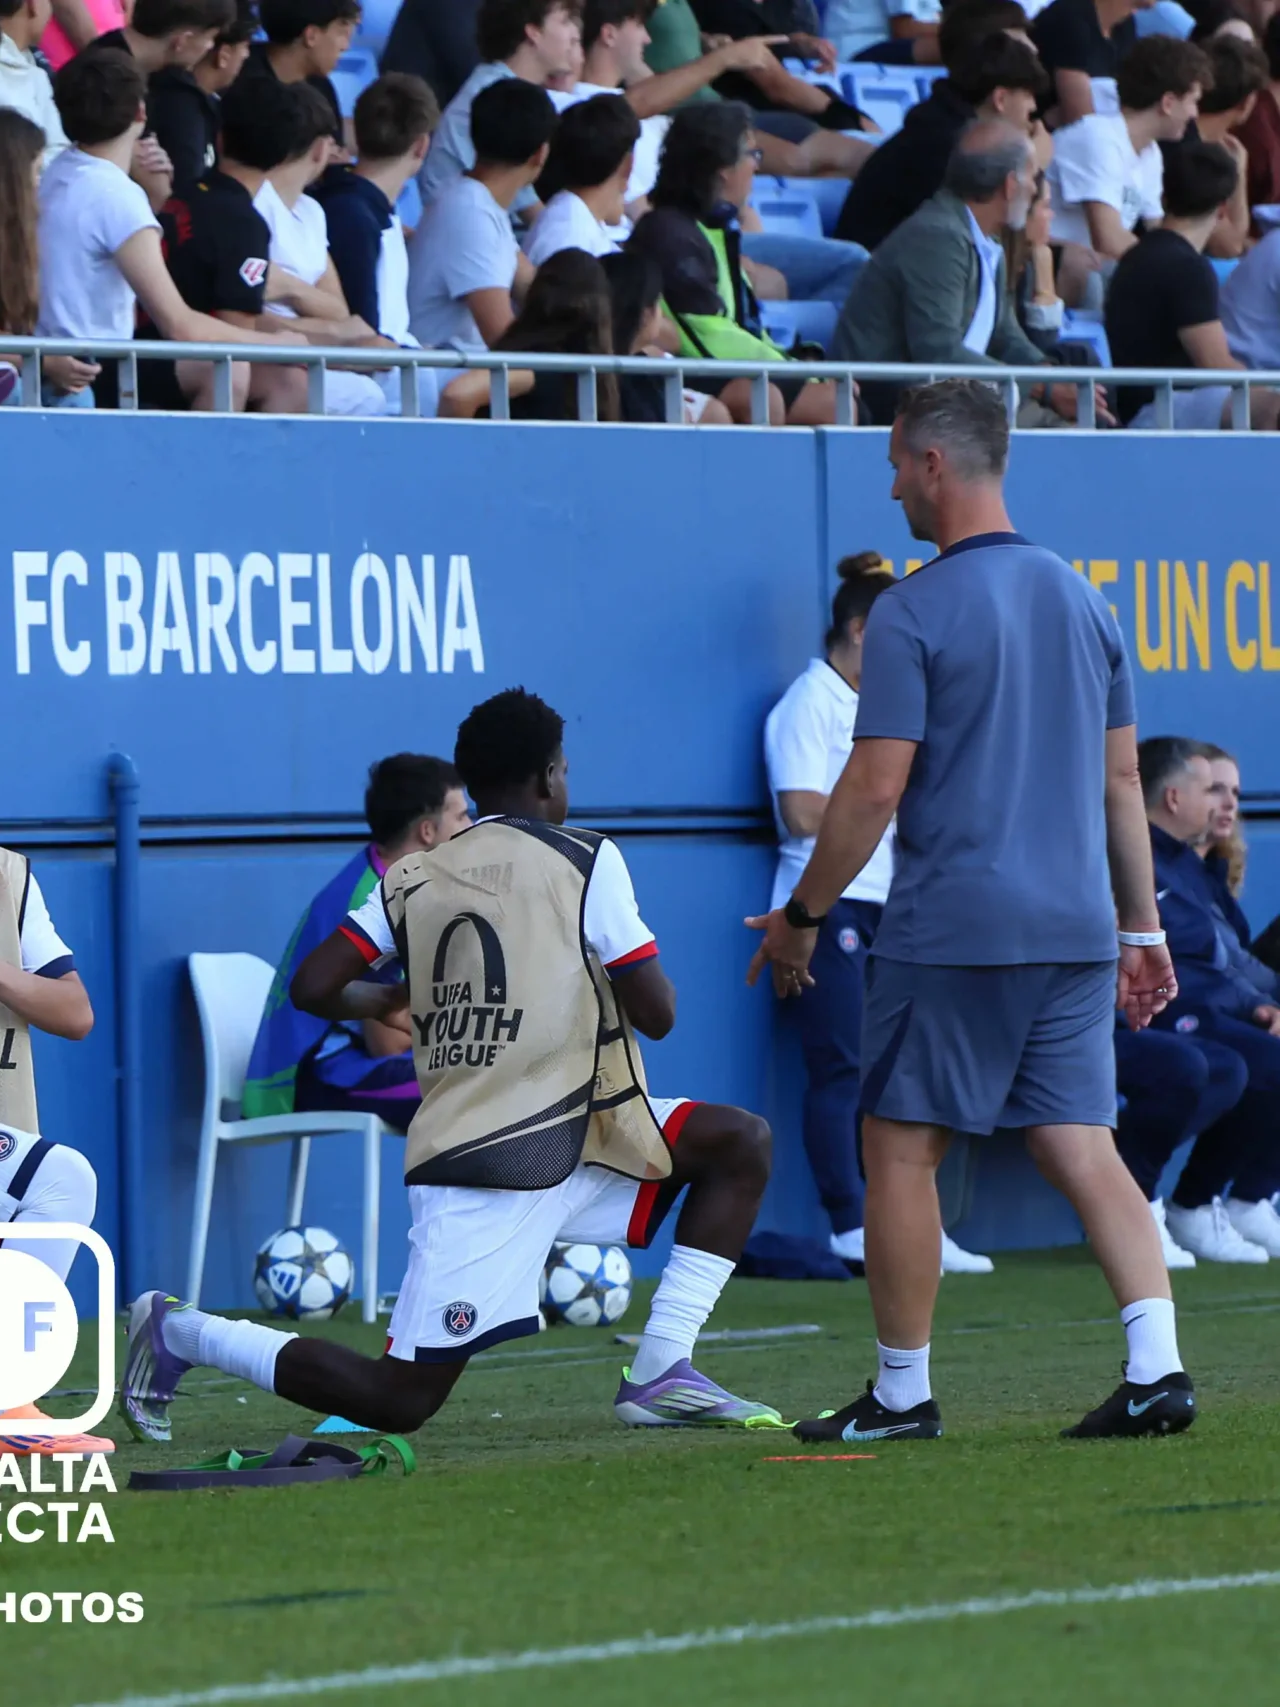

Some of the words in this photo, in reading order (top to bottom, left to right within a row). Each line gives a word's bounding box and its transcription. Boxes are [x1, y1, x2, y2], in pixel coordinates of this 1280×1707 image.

[12, 550, 91, 676] FC
[104, 551, 484, 675] BARCELONA
[1134, 559, 1212, 671] UN
[432, 982, 473, 1008] UEFA
[411, 1007, 524, 1046] YOUTH
[450, 1304, 473, 1313] PARIS
